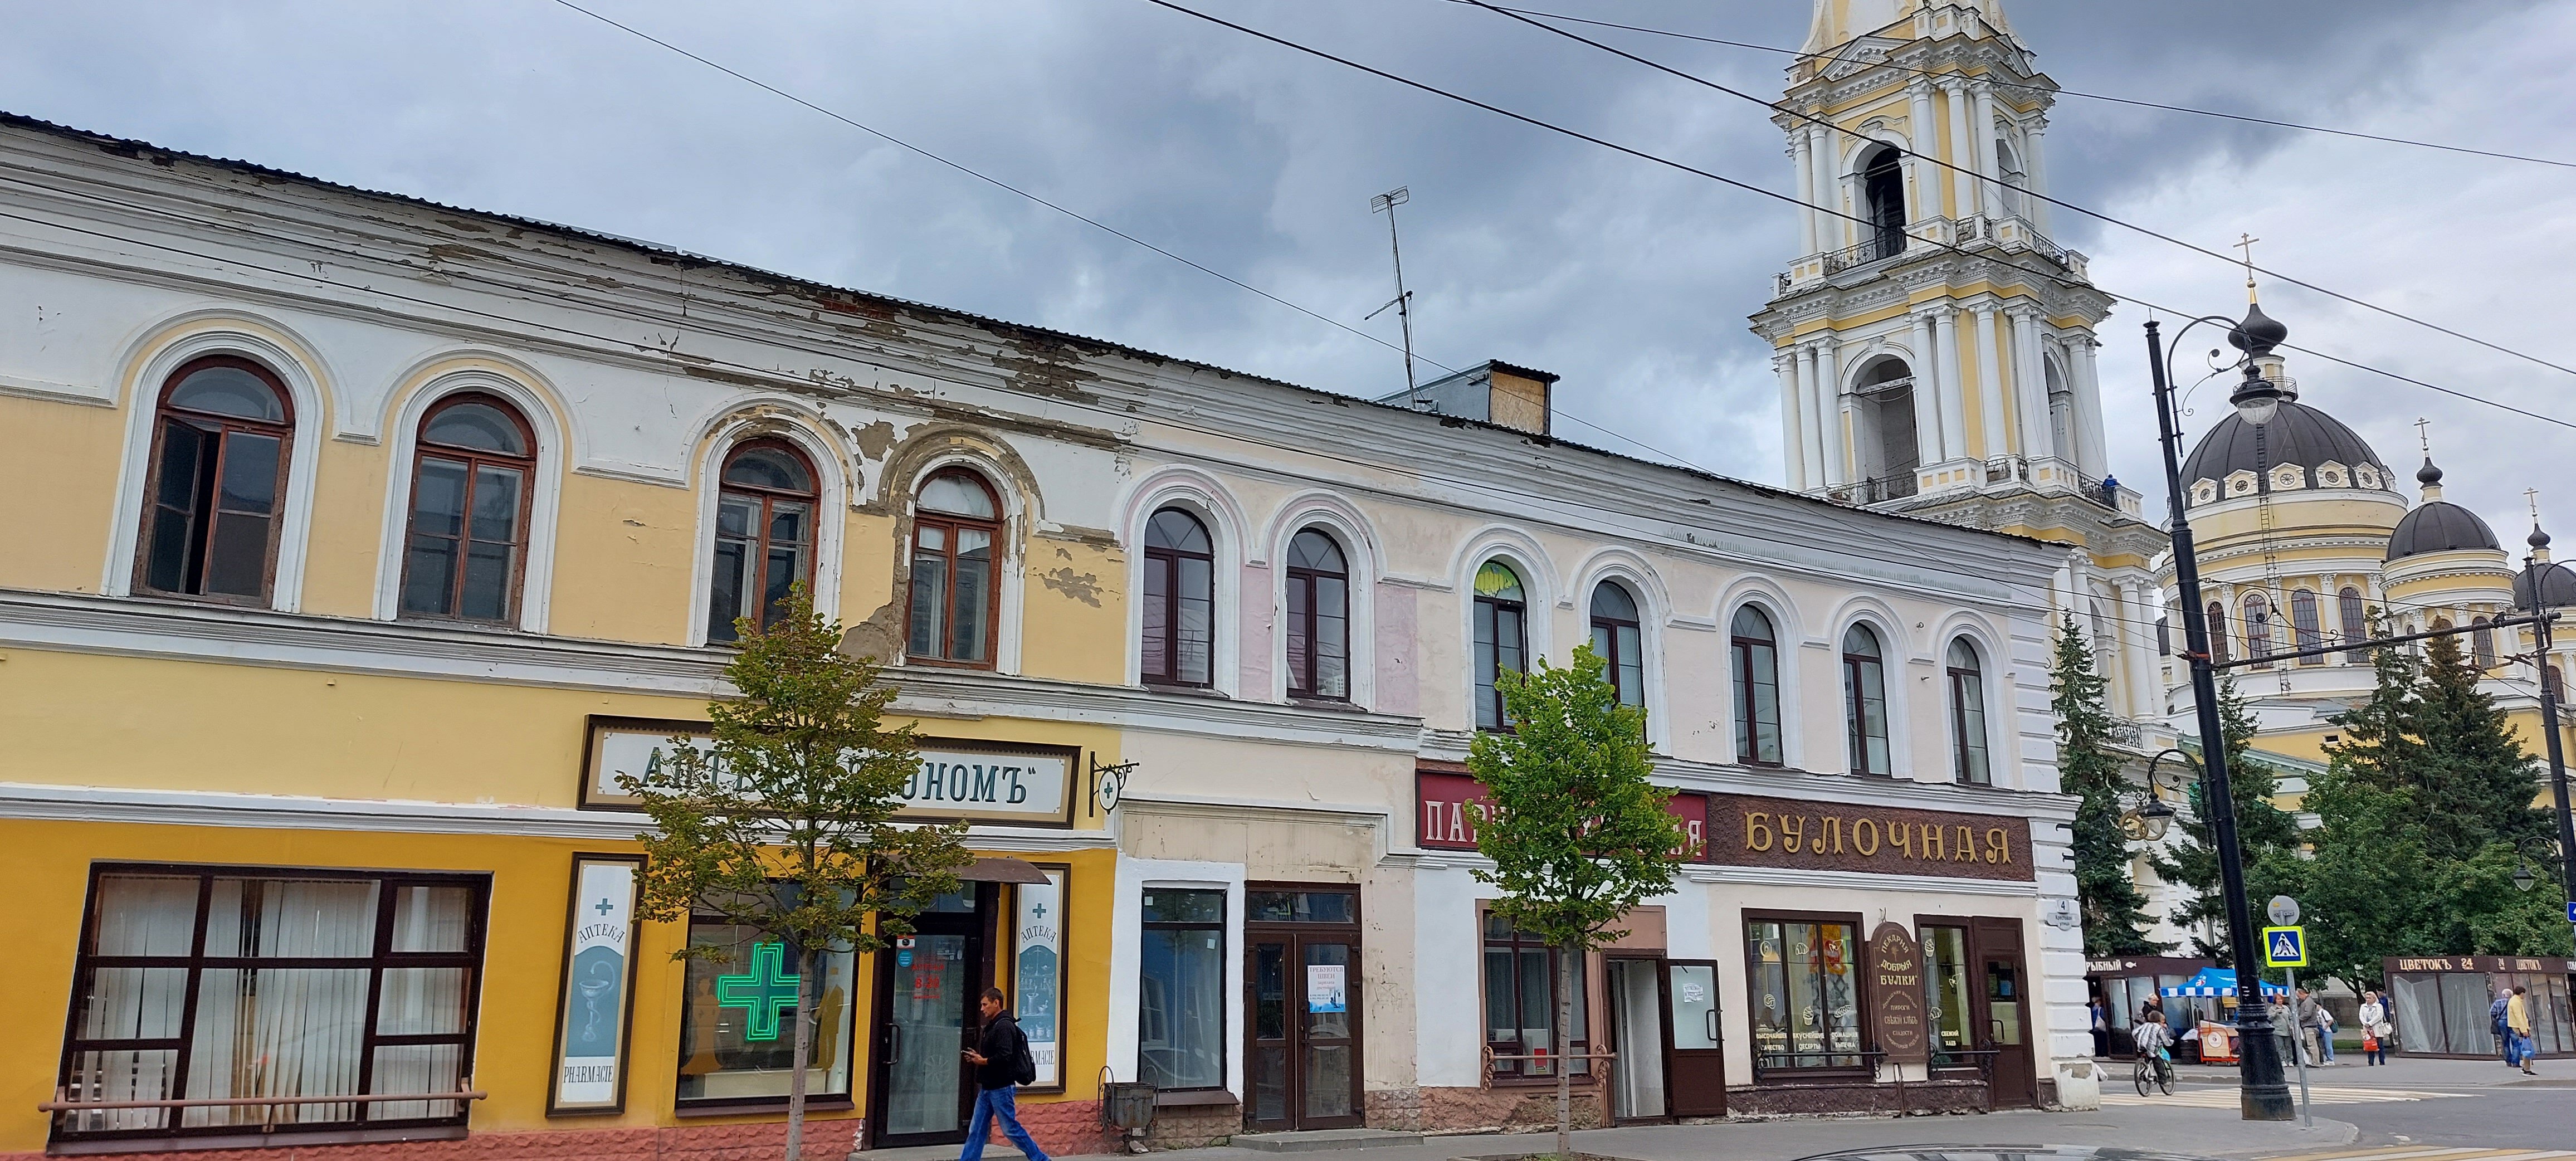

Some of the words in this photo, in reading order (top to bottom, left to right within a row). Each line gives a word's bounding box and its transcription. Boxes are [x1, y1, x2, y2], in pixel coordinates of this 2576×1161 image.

[1744, 811, 2012, 865] БУЛОЧНАЯ
[2061, 900, 2065, 910] 4
[578, 923, 625, 944] АПТЕКА
[1021, 925, 1057, 943] АПТЕКА
[1881, 934, 1909, 954] ПЕКАРНЯ
[2086, 959, 2122, 972] РЫБНЫЙ
[2399, 959, 2452, 972] ЦВЕТОКЪ
[2461, 958, 2473, 967] 24
[2497, 958, 2505, 967] 24
[564, 1065, 613, 1083] PHARMACIE
